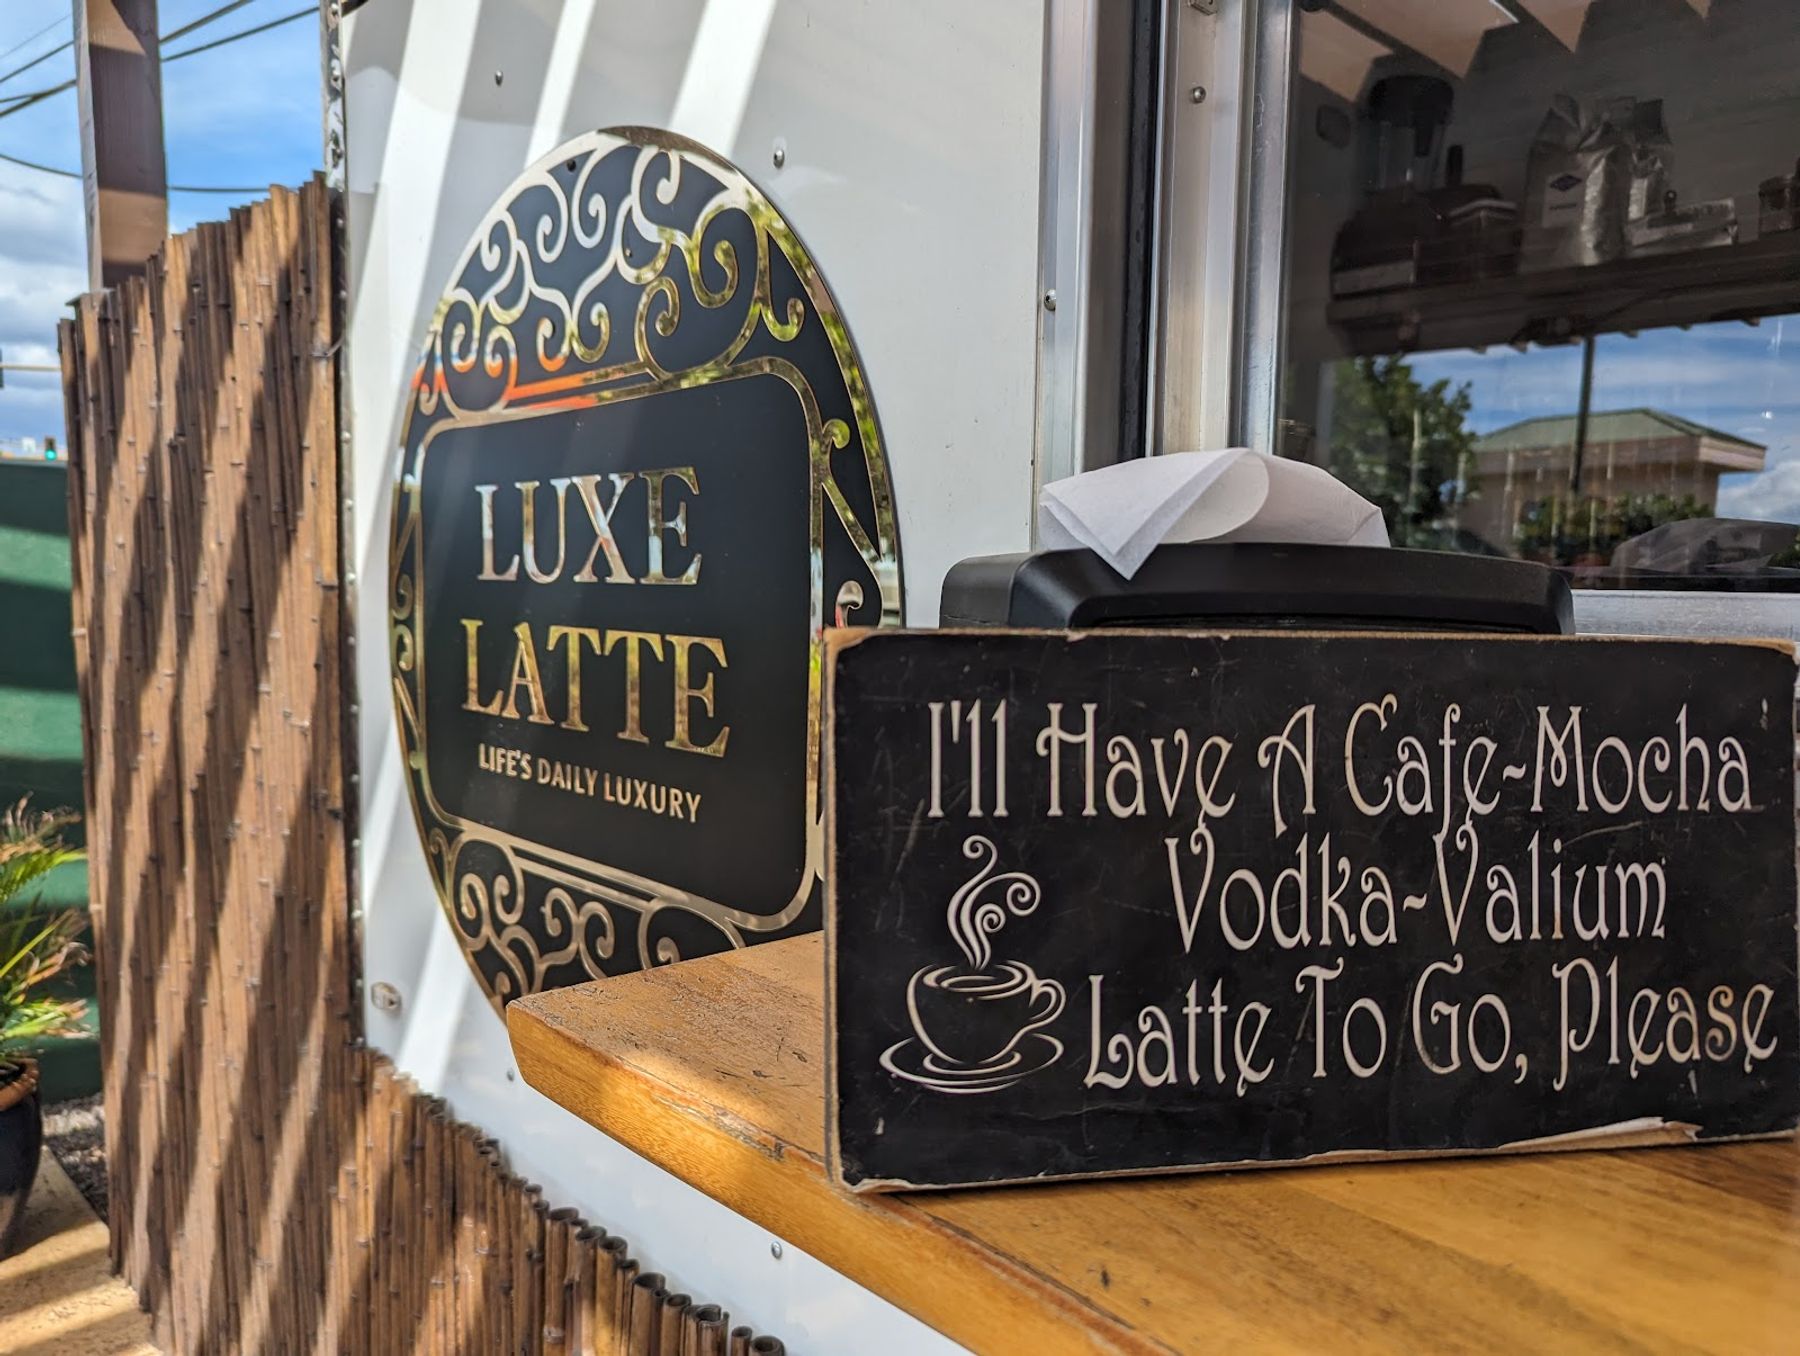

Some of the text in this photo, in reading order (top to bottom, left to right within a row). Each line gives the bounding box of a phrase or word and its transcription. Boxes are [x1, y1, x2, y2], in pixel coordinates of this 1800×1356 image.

[474, 466, 702, 586] LUXE
[460, 619, 731, 759] LATTE
[478, 743, 702, 823] LIFE'S DAILY LUXURY
[927, 698, 1008, 817] I'll
[1035, 702, 1236, 828] Have
[1257, 703, 1317, 838] A
[1083, 953, 1778, 1098] Latte To Go, Please
